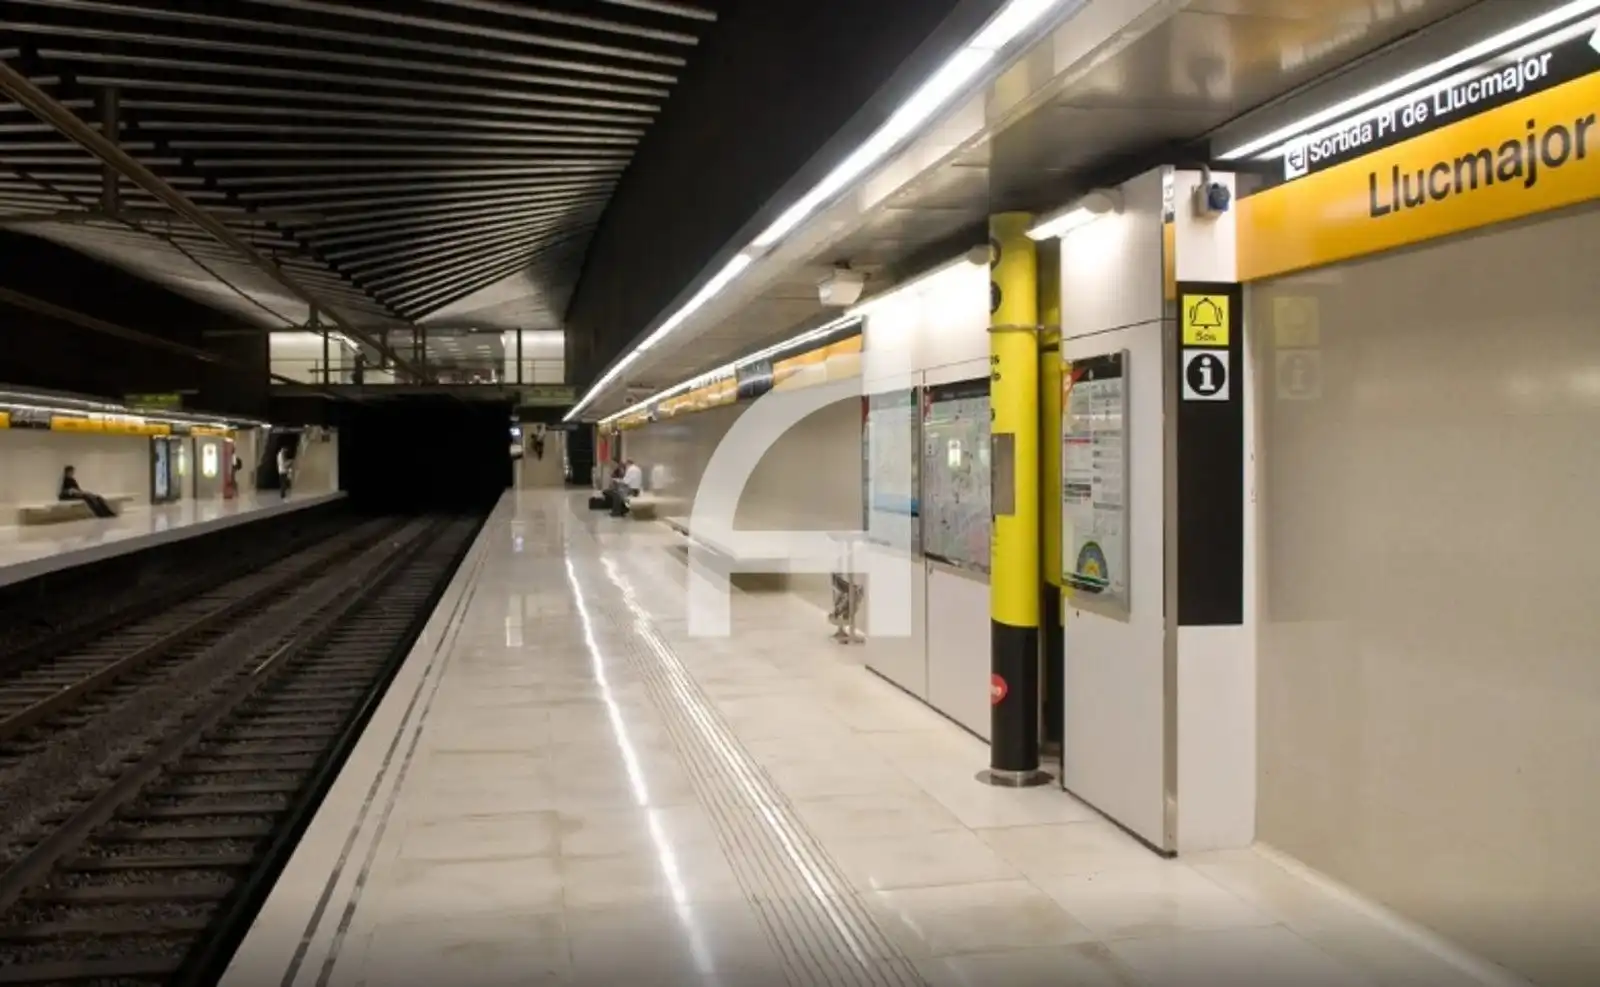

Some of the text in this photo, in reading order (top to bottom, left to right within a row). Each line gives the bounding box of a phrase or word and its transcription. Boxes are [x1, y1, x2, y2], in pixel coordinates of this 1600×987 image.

[1309, 121, 1373, 163] Sortida
[1402, 99, 1428, 129] de
[1434, 52, 1553, 117] Llucmajor
[1369, 114, 1596, 217] Llucmajor
